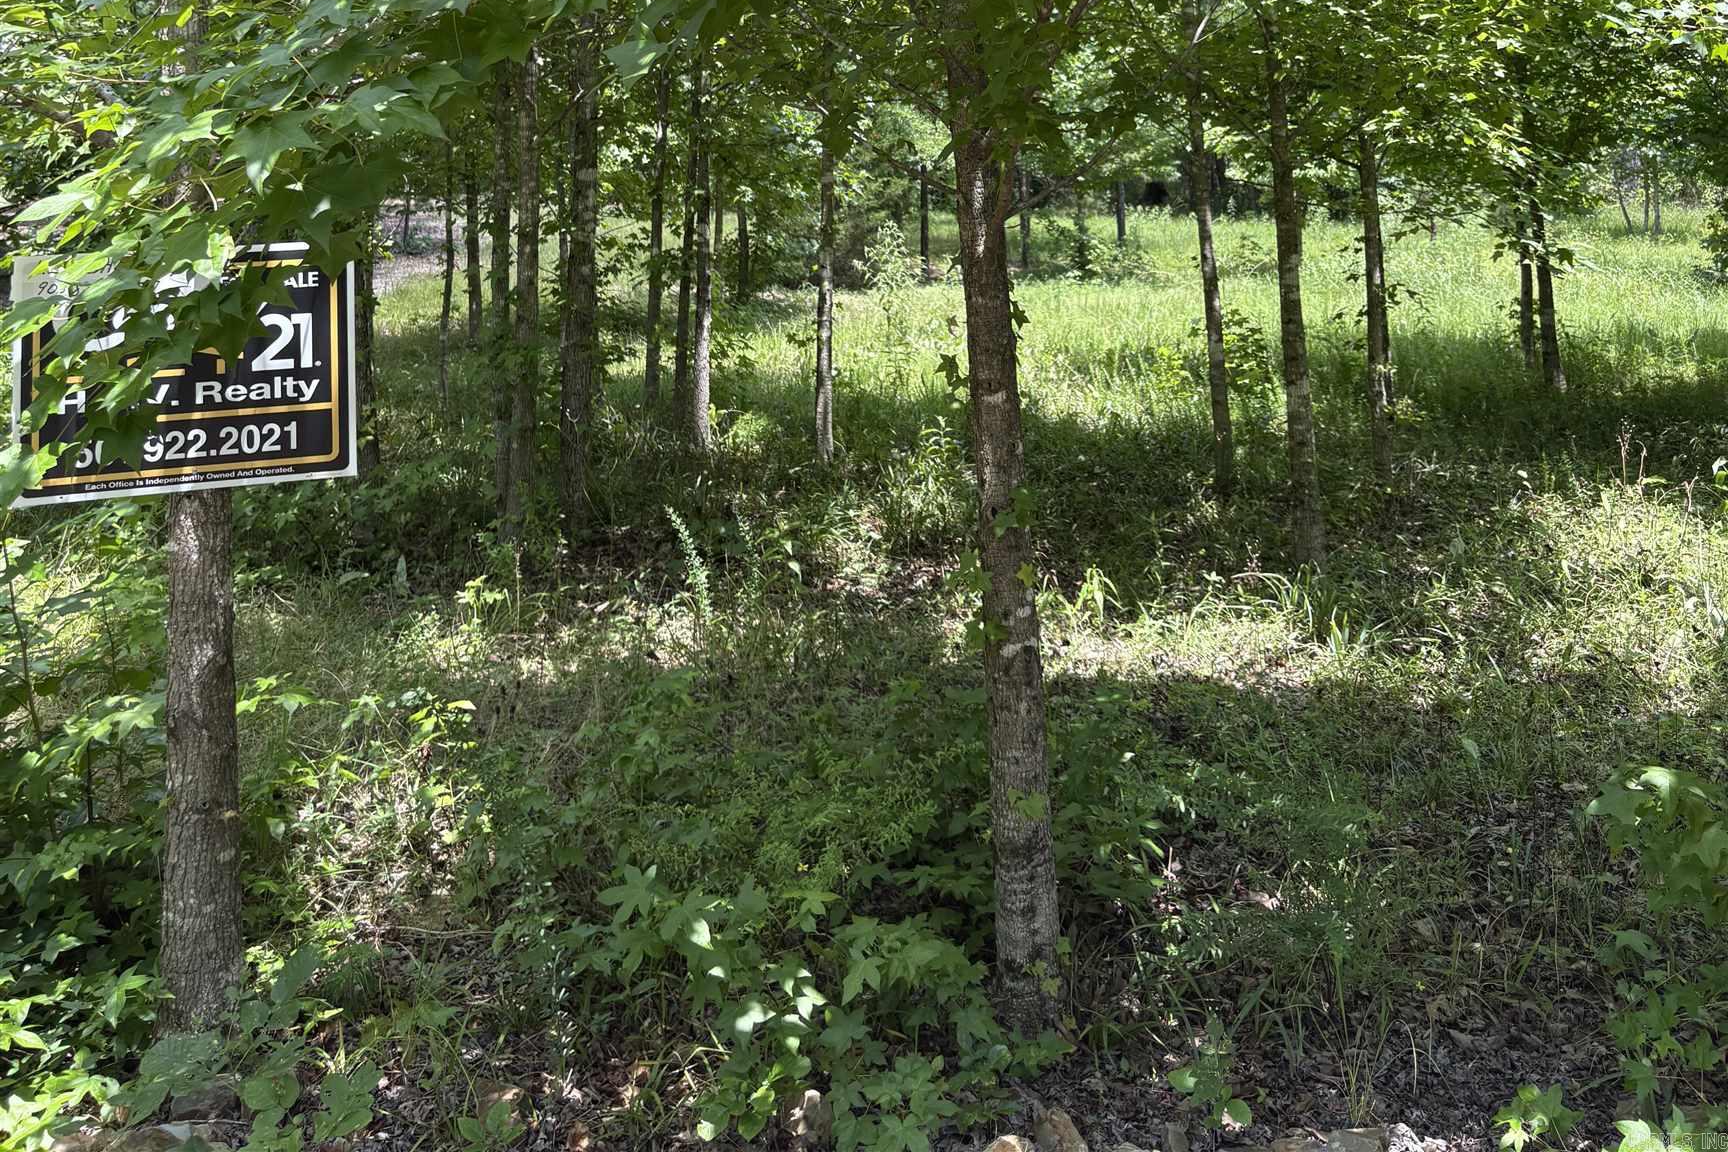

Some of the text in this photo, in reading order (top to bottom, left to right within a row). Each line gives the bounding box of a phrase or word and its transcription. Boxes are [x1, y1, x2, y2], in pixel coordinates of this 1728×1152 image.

[284, 272, 319, 288] ALE
[194, 376, 321, 405] Realty
[84, 483, 107, 491] Each
[108, 480, 135, 489] Office
[145, 473, 204, 486] Independently
[206, 470, 235, 480] Owned
[236, 469, 254, 477] And
